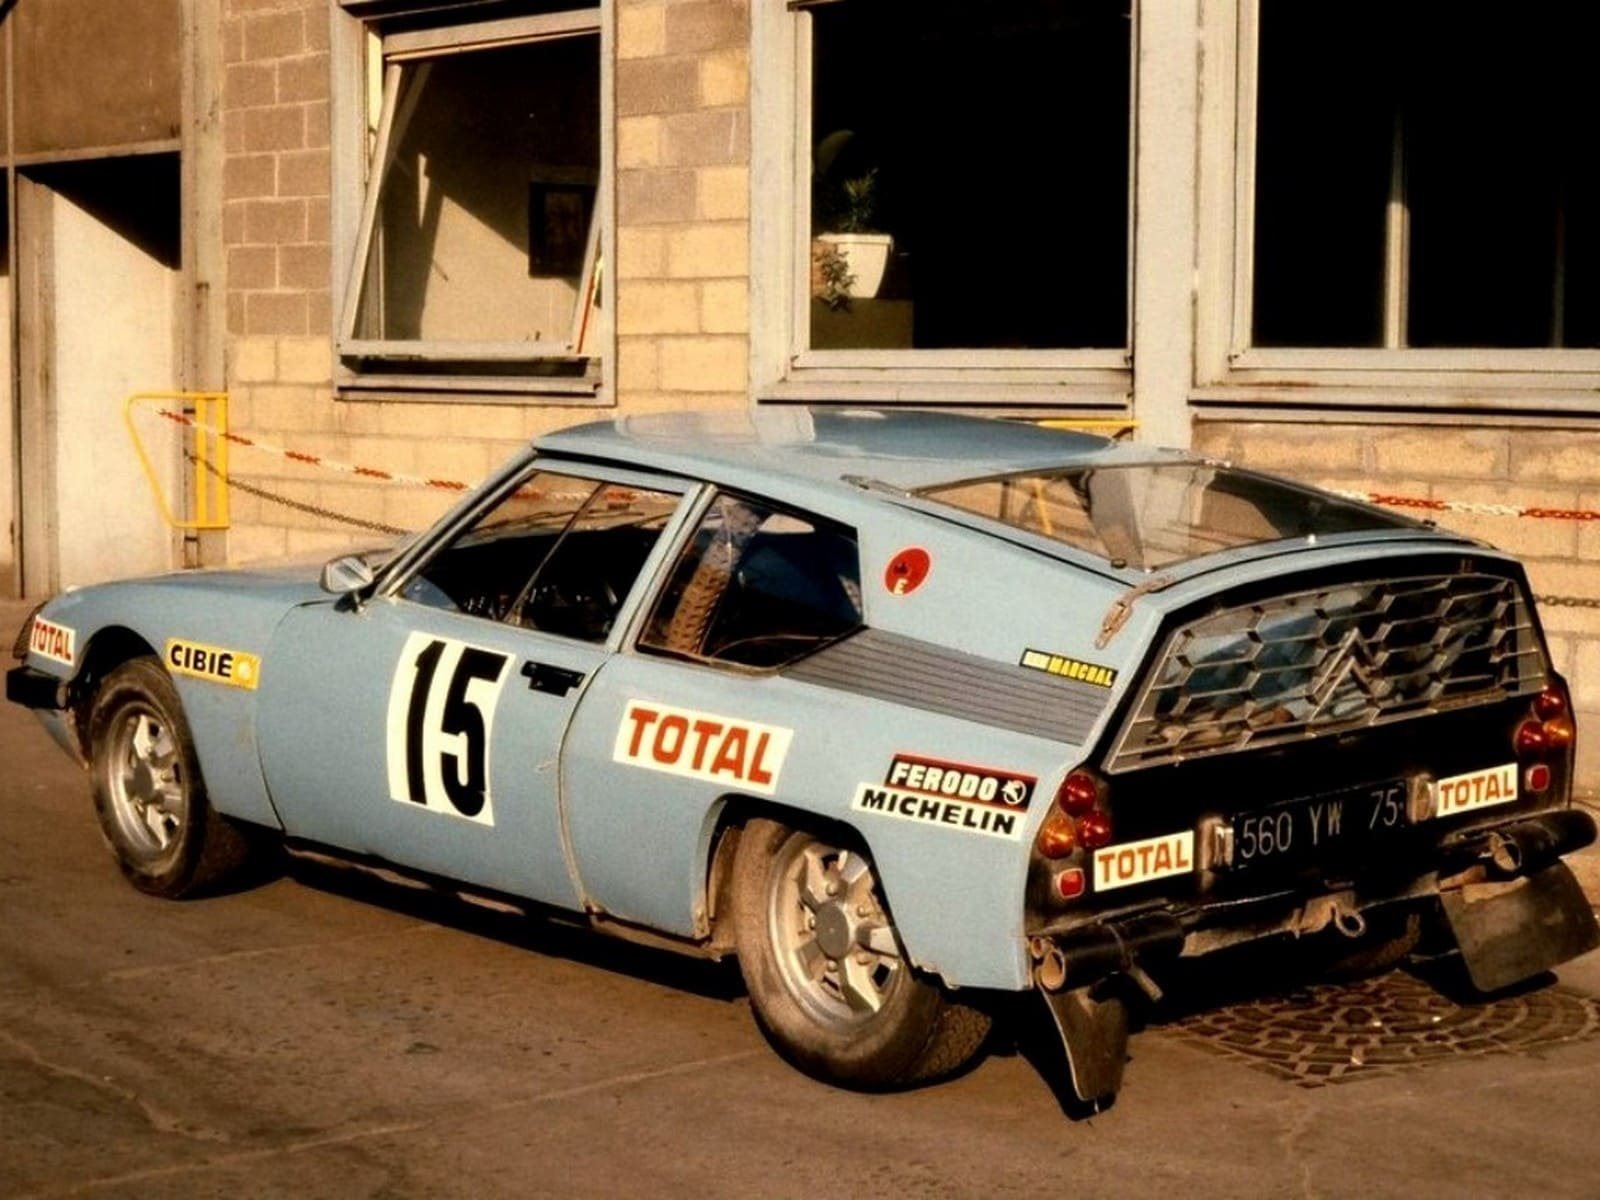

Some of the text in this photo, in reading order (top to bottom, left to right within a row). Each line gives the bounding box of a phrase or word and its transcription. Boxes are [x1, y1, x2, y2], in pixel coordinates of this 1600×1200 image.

[33, 621, 71, 661] TOTAL
[406, 640, 509, 817] 15
[629, 707, 772, 785] TOTAL
[890, 762, 998, 801] FERODO
[1439, 772, 1516, 811] TOTAL
[861, 789, 1016, 835] MICHELIN
[1241, 789, 1399, 858] 560 YW 75
[1098, 838, 1190, 884] TOTAL
